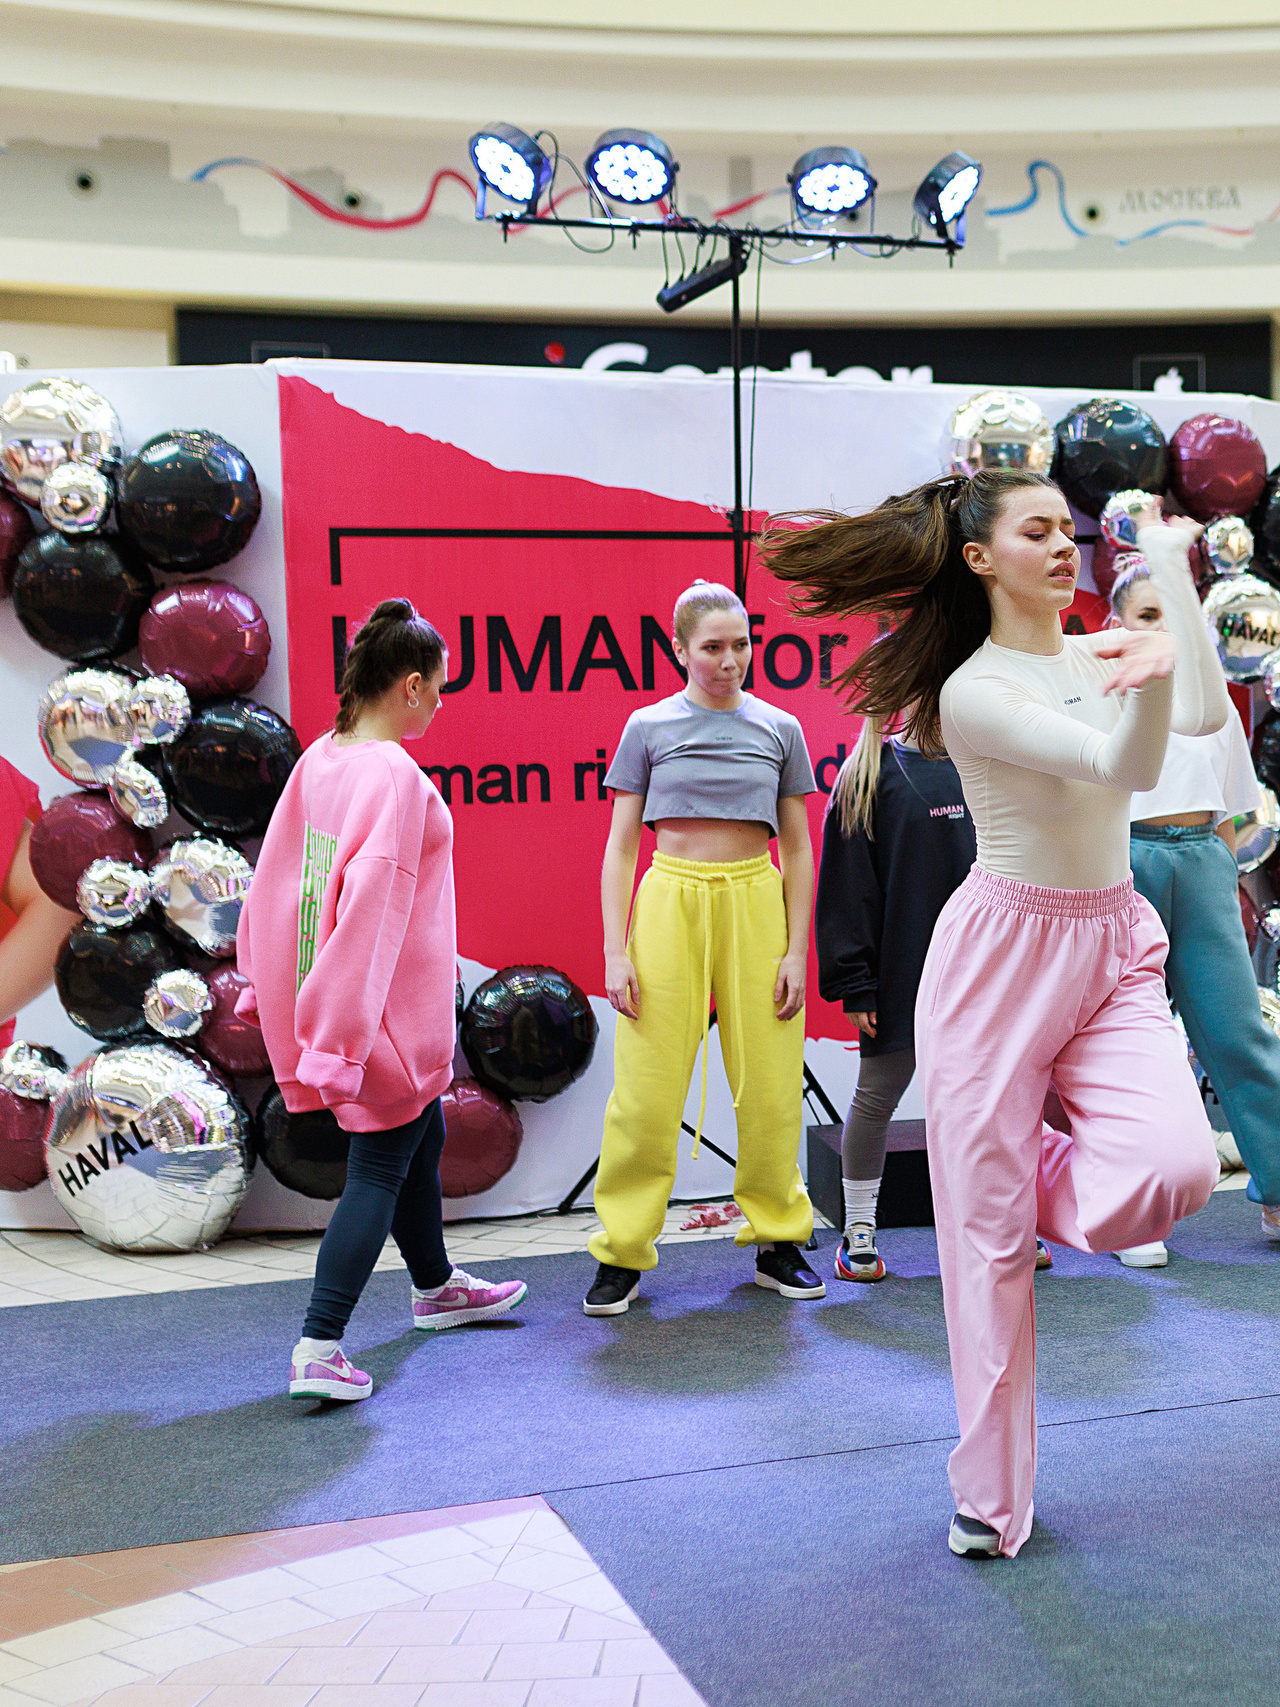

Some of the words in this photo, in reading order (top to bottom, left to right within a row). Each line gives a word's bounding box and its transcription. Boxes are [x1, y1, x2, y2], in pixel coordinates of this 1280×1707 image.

[1219, 611, 1276, 646] HAVAL
[929, 804, 965, 817] HUMAN
[58, 1120, 154, 1197] HAVAL
